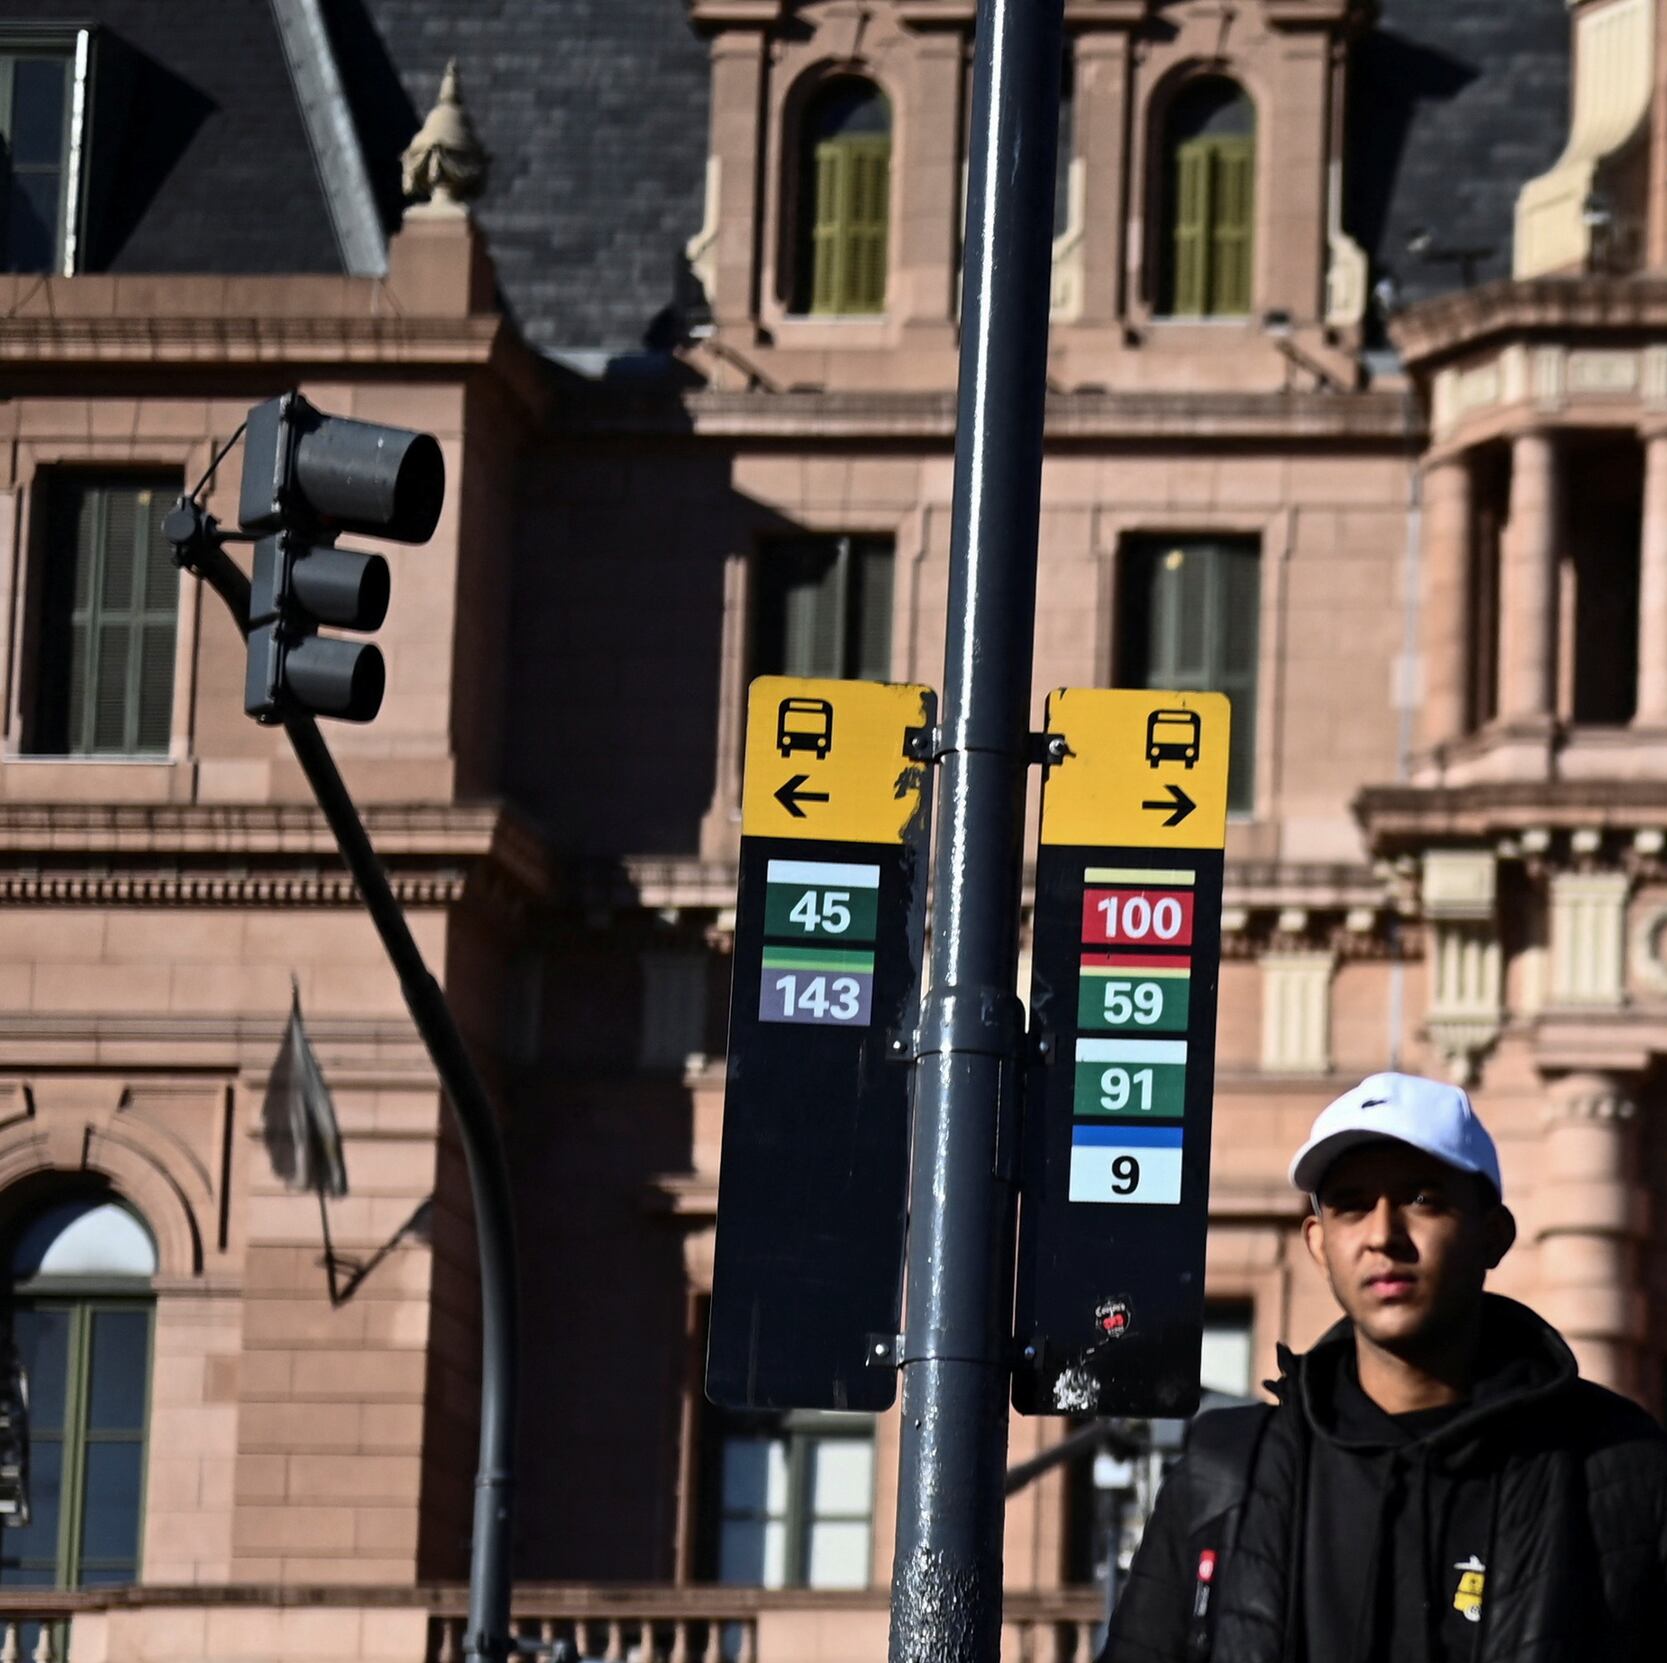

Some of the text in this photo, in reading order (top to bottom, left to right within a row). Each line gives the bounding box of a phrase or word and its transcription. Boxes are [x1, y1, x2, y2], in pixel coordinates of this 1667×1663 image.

[789, 890, 851, 934] 45
[1097, 896, 1182, 940] 100
[776, 975, 860, 1020] 143
[1103, 981, 1164, 1025] 59
[1100, 1067, 1153, 1110] 91
[1111, 1155, 1140, 1195] 9
